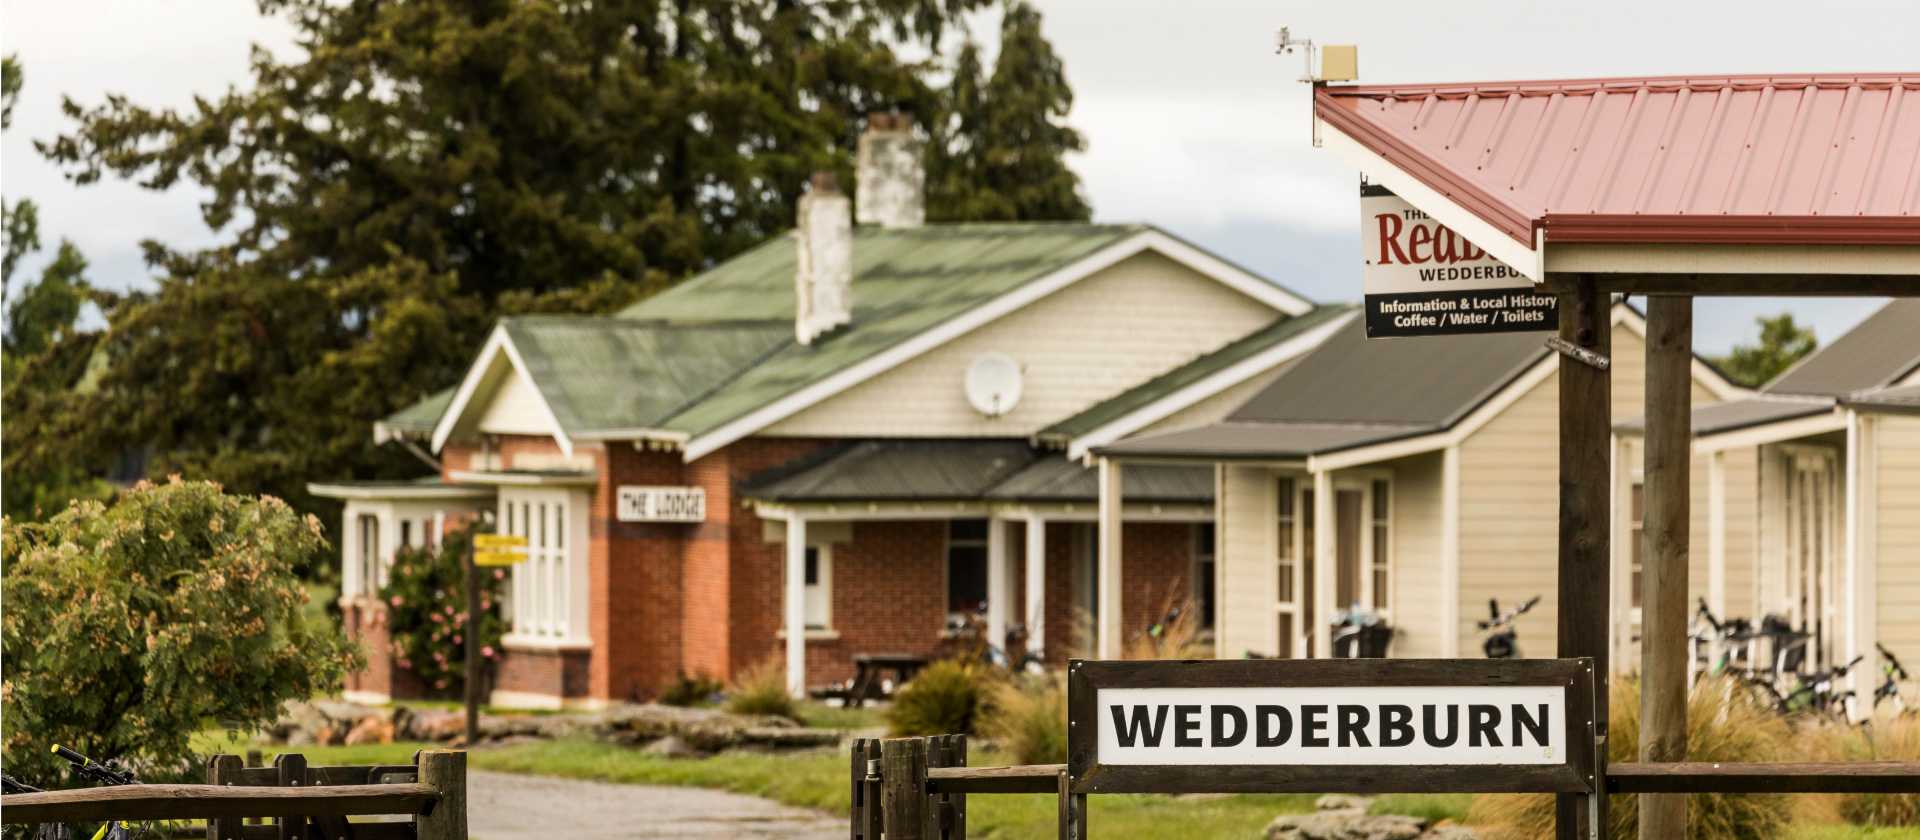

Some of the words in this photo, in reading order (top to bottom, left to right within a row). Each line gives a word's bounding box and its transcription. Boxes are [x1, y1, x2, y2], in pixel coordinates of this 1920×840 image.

[1419, 265, 1525, 282] WEDDERBU
[1380, 298, 1456, 313] Information
[1460, 298, 1471, 310] &
[1474, 296, 1507, 309] Local
[1511, 295, 1557, 309] History
[1394, 313, 1436, 327] Coffee
[1439, 313, 1447, 328] /
[1450, 312, 1488, 325] Water
[1491, 311, 1499, 325] /
[1502, 310, 1544, 323] Toilets
[623, 492, 647, 515] THE
[656, 493, 700, 515] LODGE
[1110, 703, 1550, 748] WEDDERBURN
